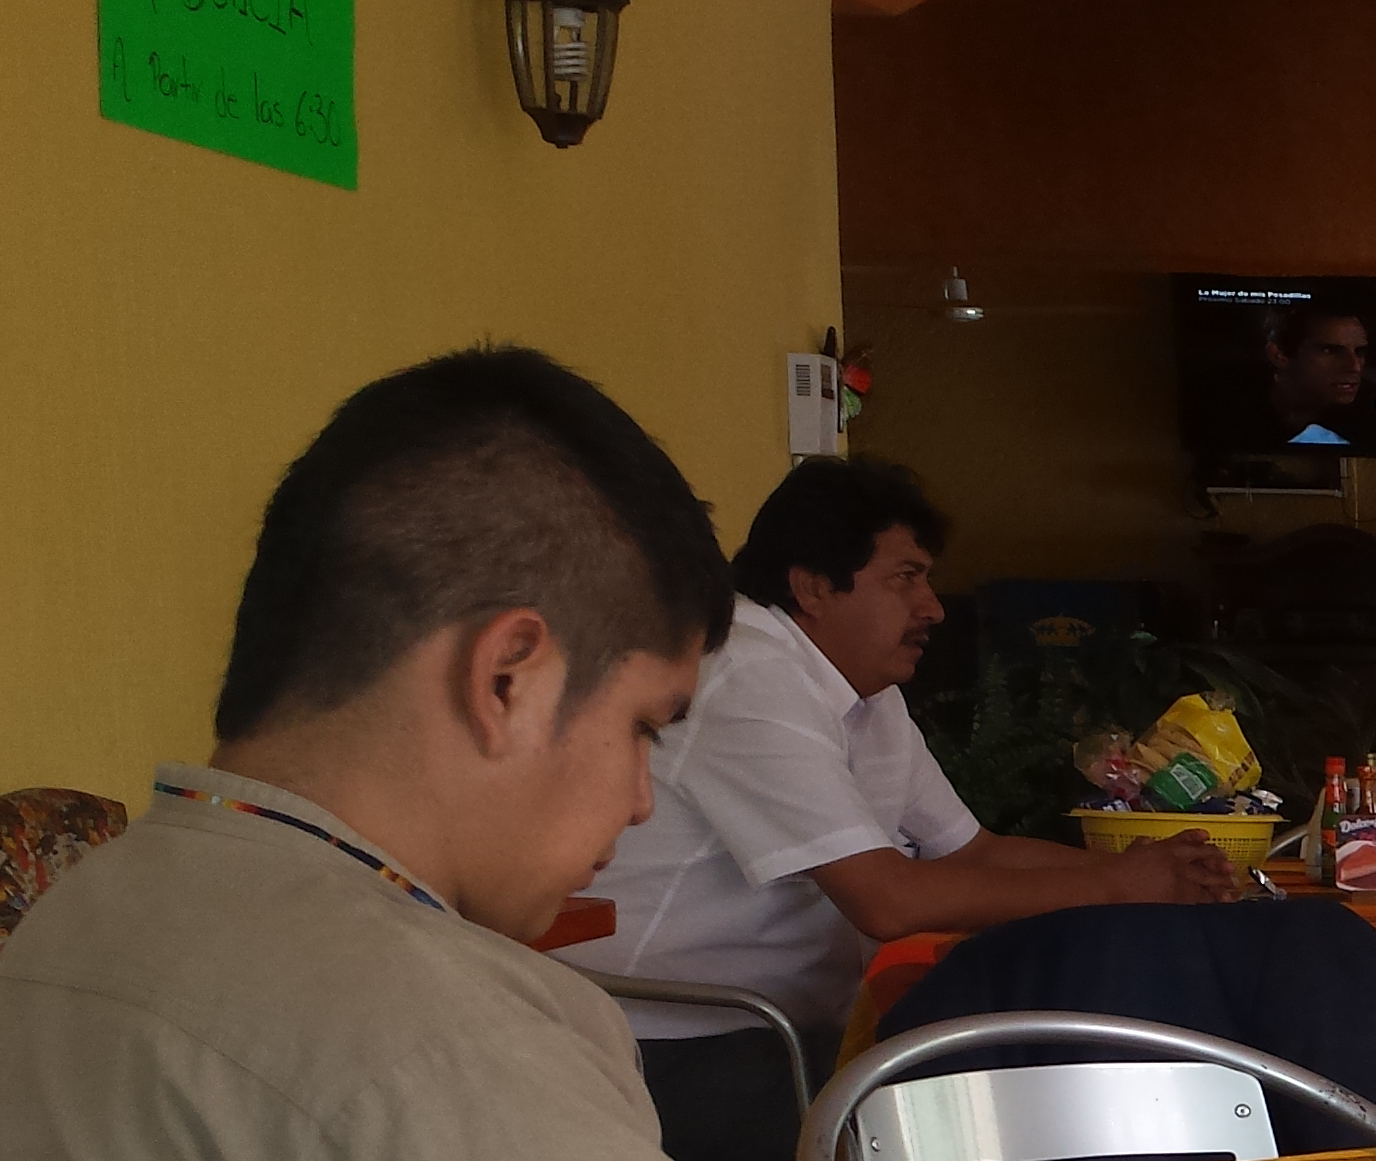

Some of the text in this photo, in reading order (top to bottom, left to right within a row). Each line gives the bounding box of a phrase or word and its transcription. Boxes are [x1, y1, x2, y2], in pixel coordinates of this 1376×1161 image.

[112, 36, 131, 102] A
[214, 66, 240, 119] de
[253, 71, 285, 128] las
